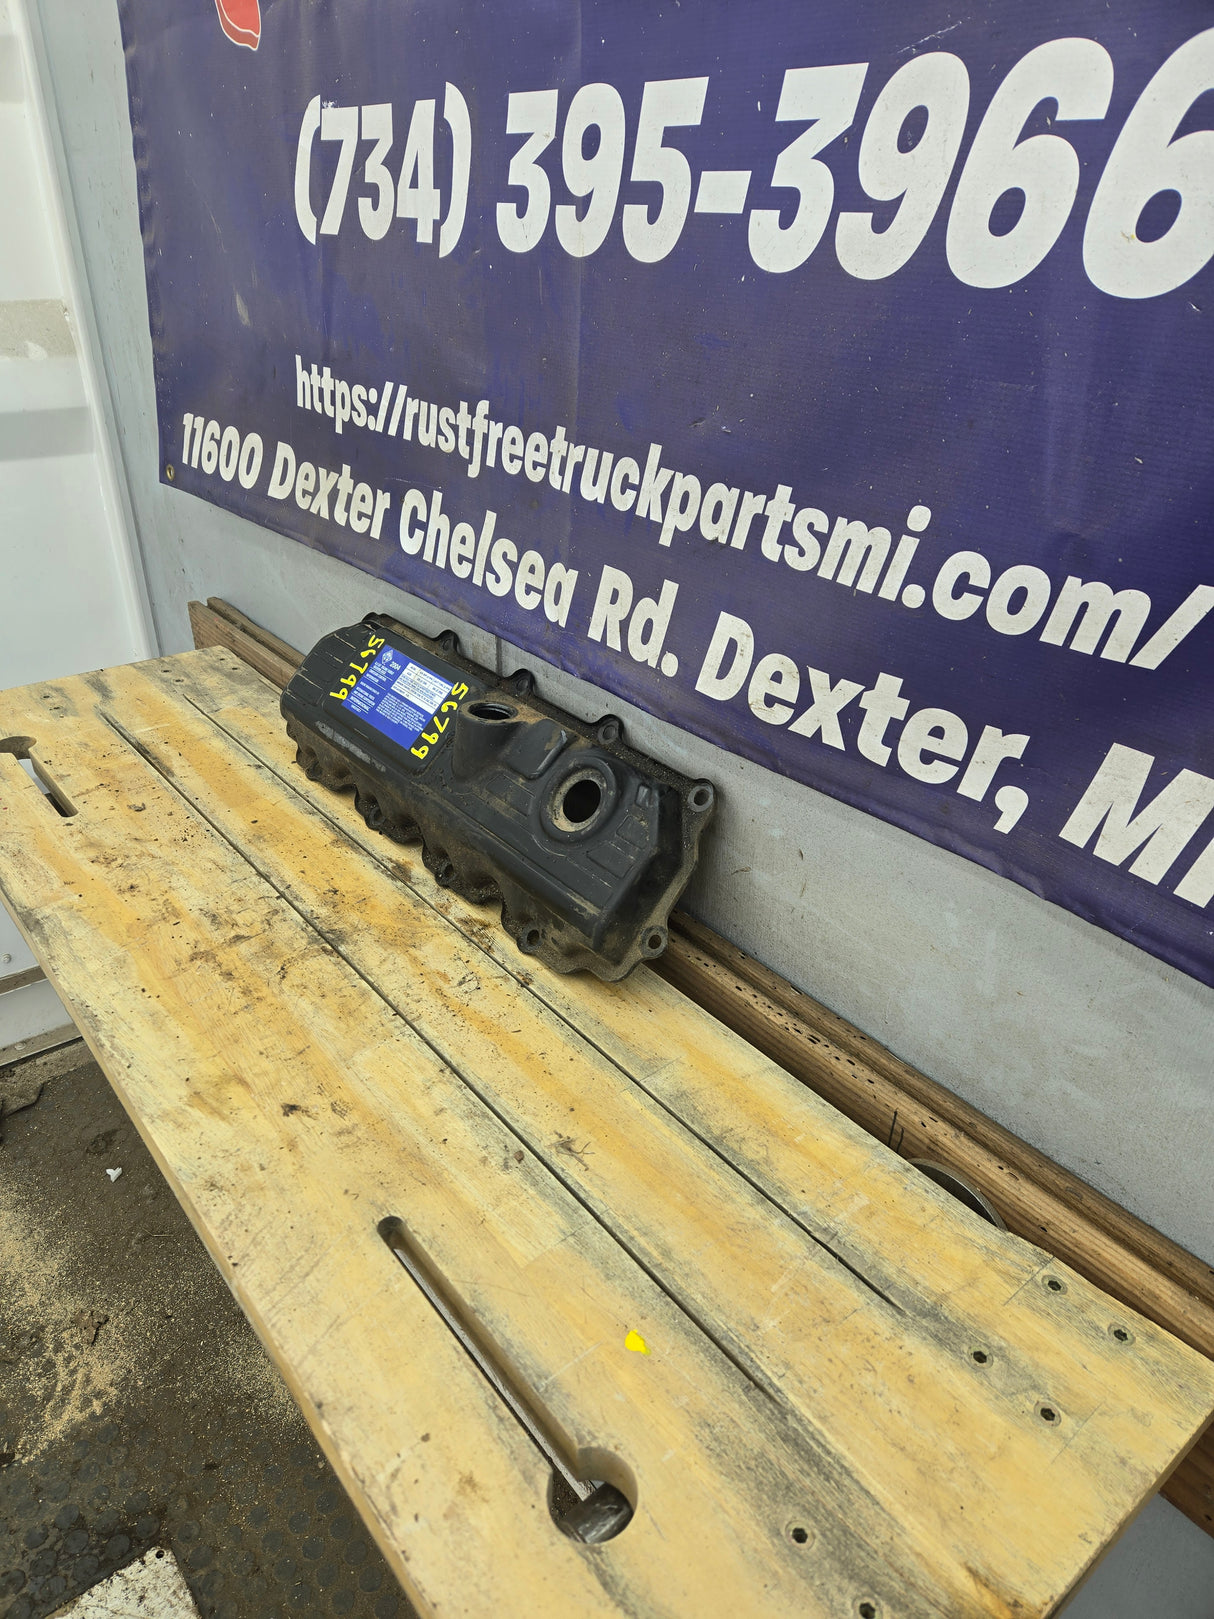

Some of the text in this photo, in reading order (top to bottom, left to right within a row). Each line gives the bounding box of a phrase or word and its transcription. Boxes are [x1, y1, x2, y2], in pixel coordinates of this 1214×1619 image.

[295, 27, 1214, 299] (734) 395-3966
[182, 413, 263, 490] 11600
[268, 442, 391, 540] Dexter
[399, 489, 578, 629] Chelsea
[588, 565, 679, 678] Rd.
[695, 611, 1031, 835] Dexter,
[295, 355, 1214, 671] https://rustfreetruckpartsmi.com/
[411, 682, 469, 760] 56799
